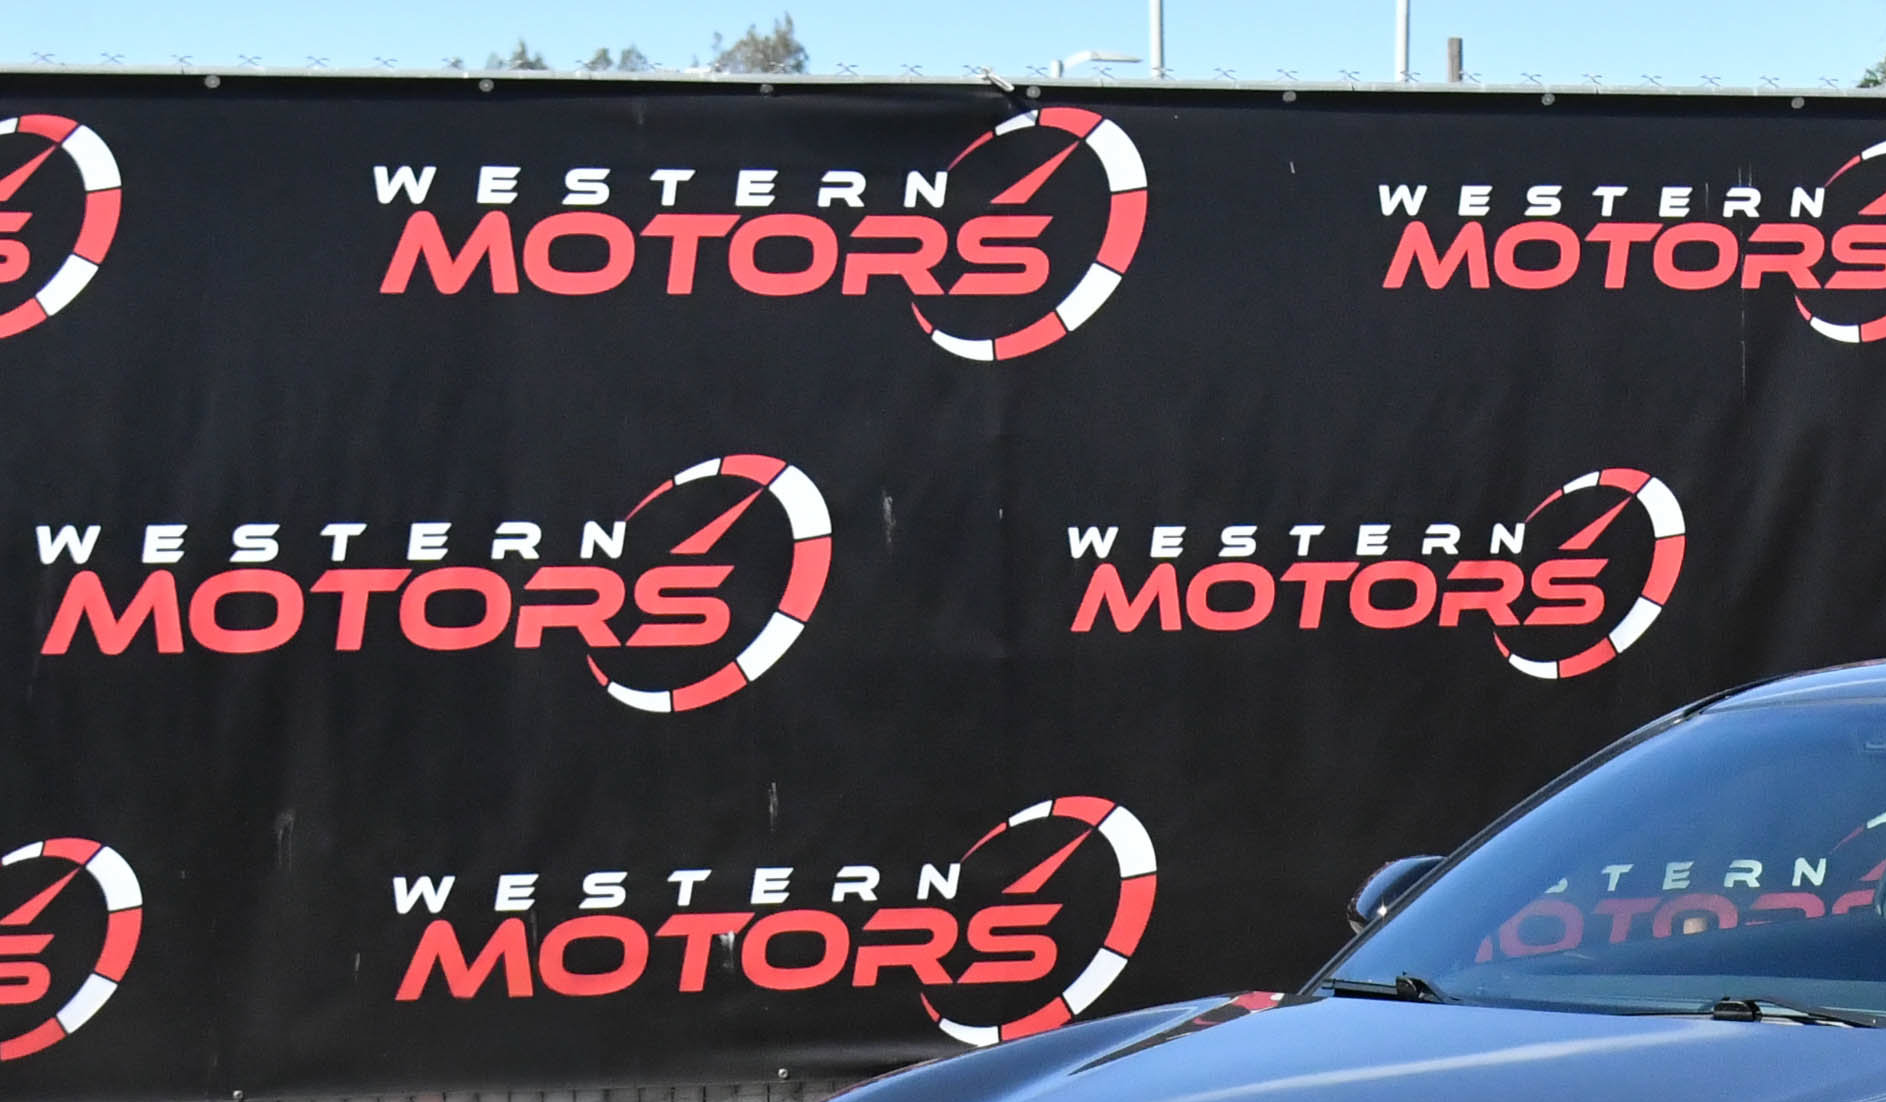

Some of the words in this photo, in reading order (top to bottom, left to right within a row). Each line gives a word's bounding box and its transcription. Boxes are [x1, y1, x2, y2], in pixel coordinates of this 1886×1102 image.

[374, 166, 948, 209] WESTERN
[1379, 185, 1825, 218] WESTERN
[380, 210, 1053, 297] MOTORS
[36, 521, 627, 565] WESTERN
[1068, 523, 1526, 559] WESTERN
[41, 565, 735, 656] MOTORS
[1071, 558, 1609, 633] MOTORS
[393, 864, 961, 915] WESTERN
[396, 904, 1063, 1002] MOTORS
